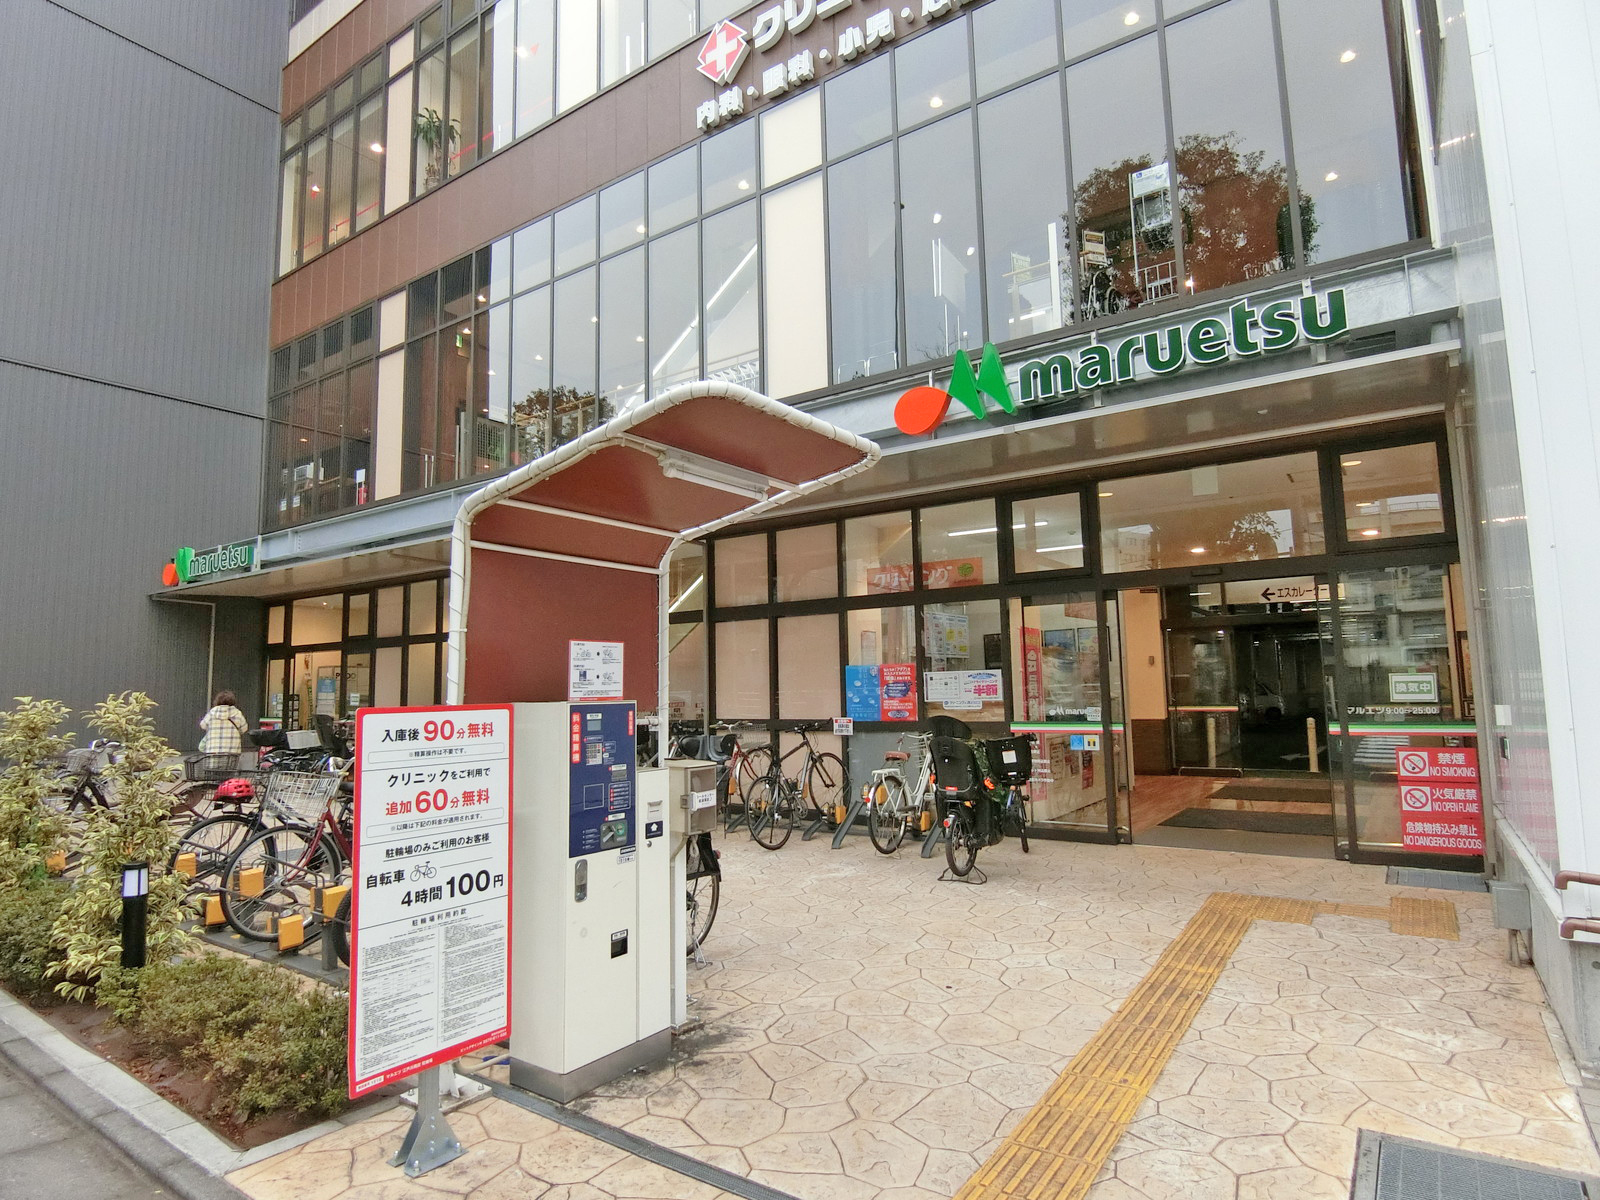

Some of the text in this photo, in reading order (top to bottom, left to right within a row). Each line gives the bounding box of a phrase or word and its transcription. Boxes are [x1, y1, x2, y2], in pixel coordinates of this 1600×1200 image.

[1018, 288, 1349, 404] maruetsu
[188, 544, 249, 577] maruetsu
[1437, 752, 1466, 764] 禁煙
[387, 767, 491, 788] クリニックをご利用で
[1430, 766, 1476, 777] NO SMOKING
[1432, 787, 1477, 800] 火気厳禁
[1433, 801, 1479, 813] NO OPEN FLAME
[1405, 821, 1478, 837] 危険物持込み禁止
[385, 832, 490, 858] 駐輪場のみご利用のお客様
[1404, 835, 1482, 849] NO DANGEROUS GOODS
[366, 869, 406, 889] 自転車
